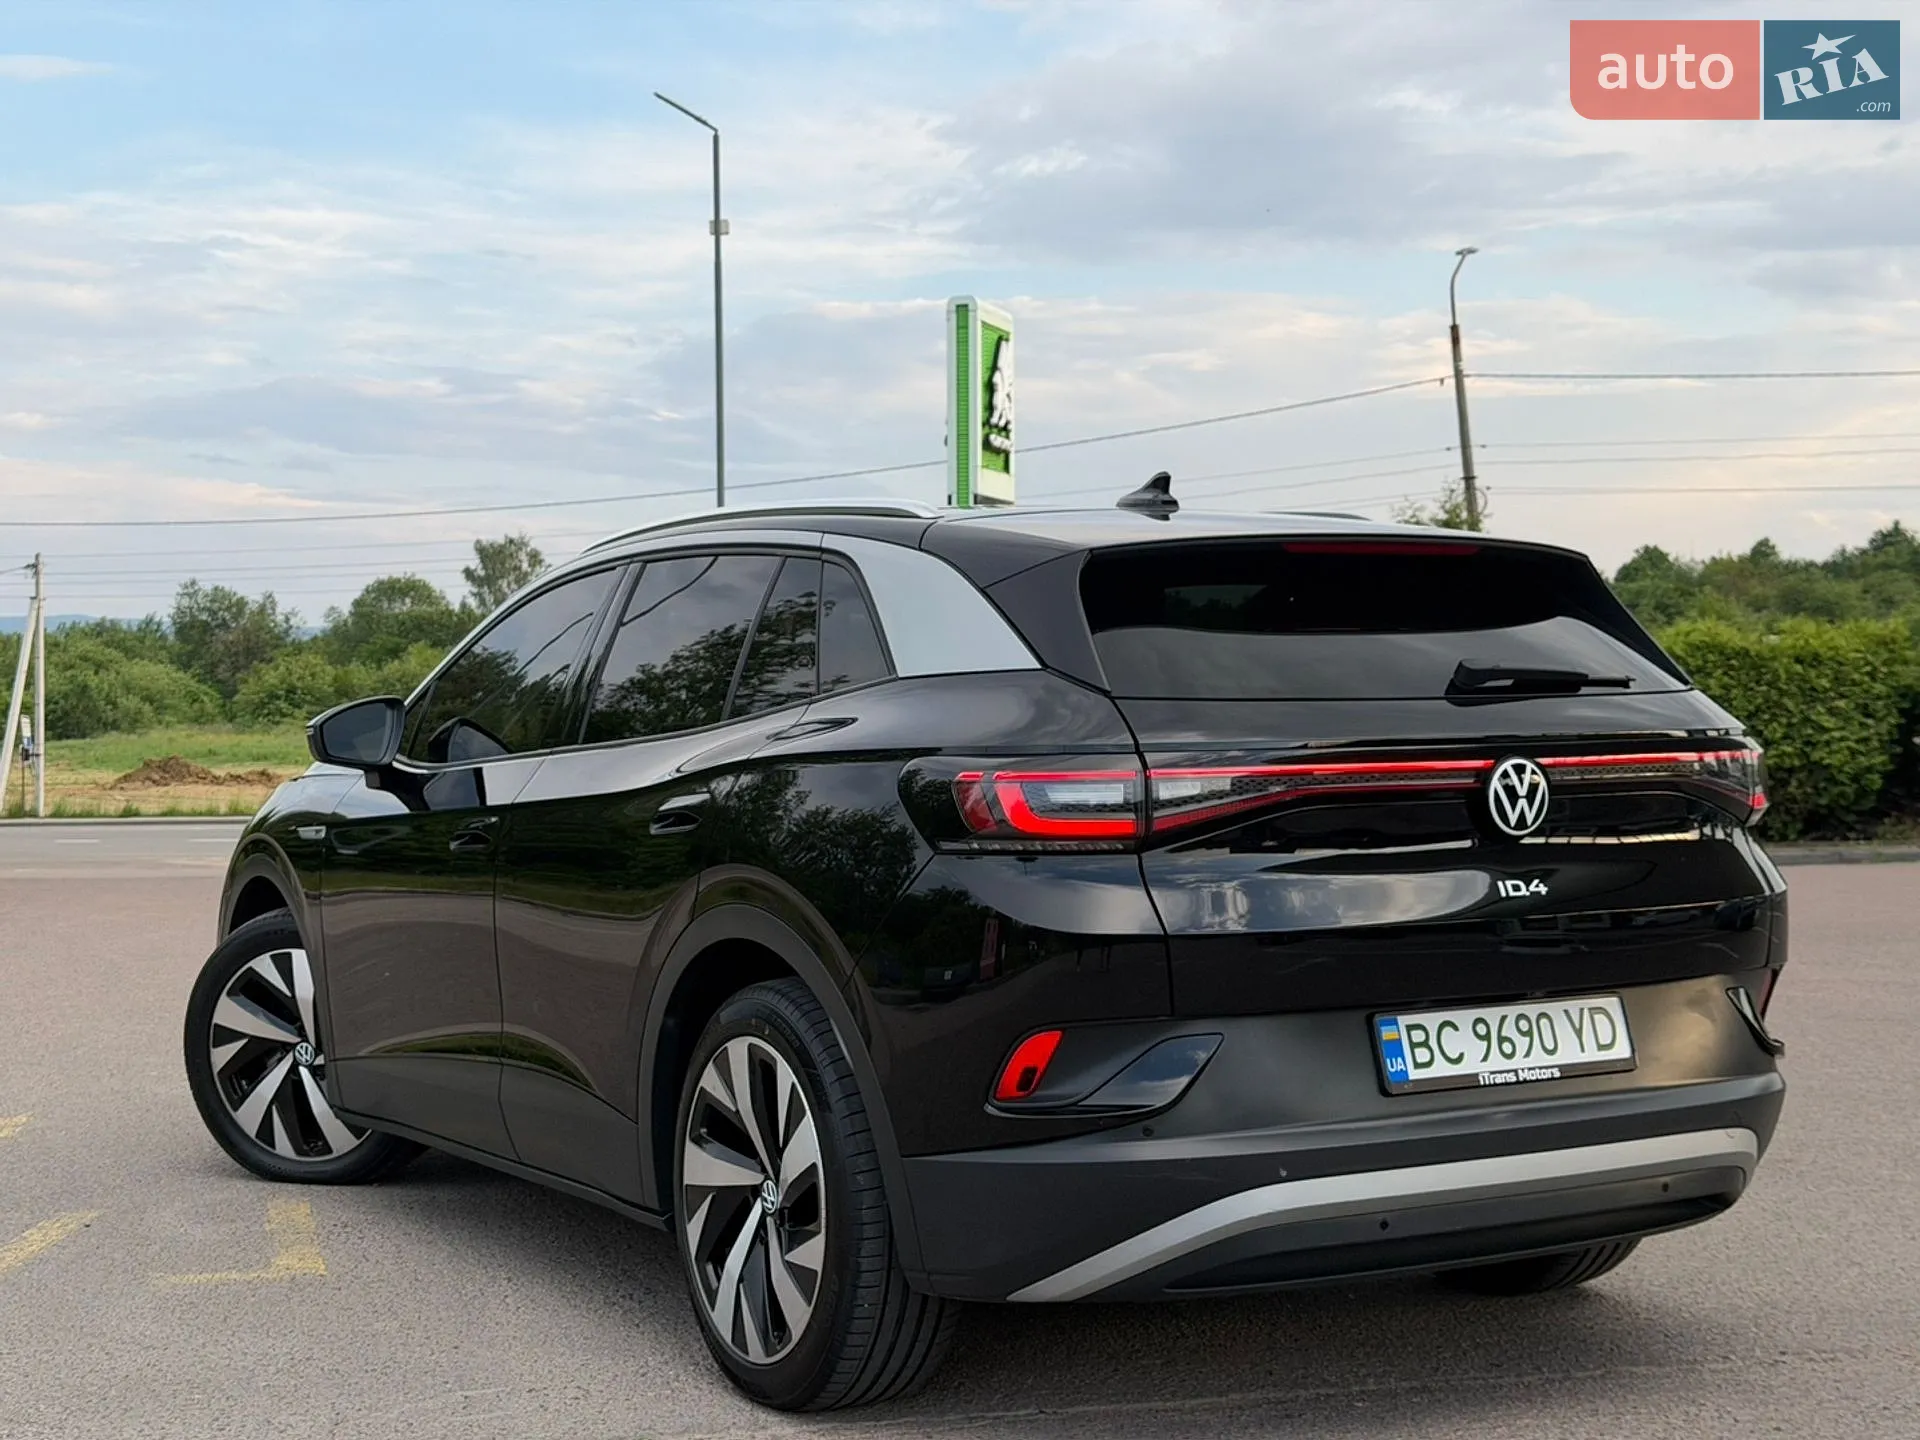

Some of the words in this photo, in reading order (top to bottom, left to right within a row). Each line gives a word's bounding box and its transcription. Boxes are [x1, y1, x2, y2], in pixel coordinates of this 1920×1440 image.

[1405, 1020, 1464, 1070] BC
[1472, 1011, 1558, 1063] 9690
[1563, 1006, 1617, 1054] YD
[1386, 1056, 1406, 1073] UA
[1518, 1067, 1561, 1081] Motors
